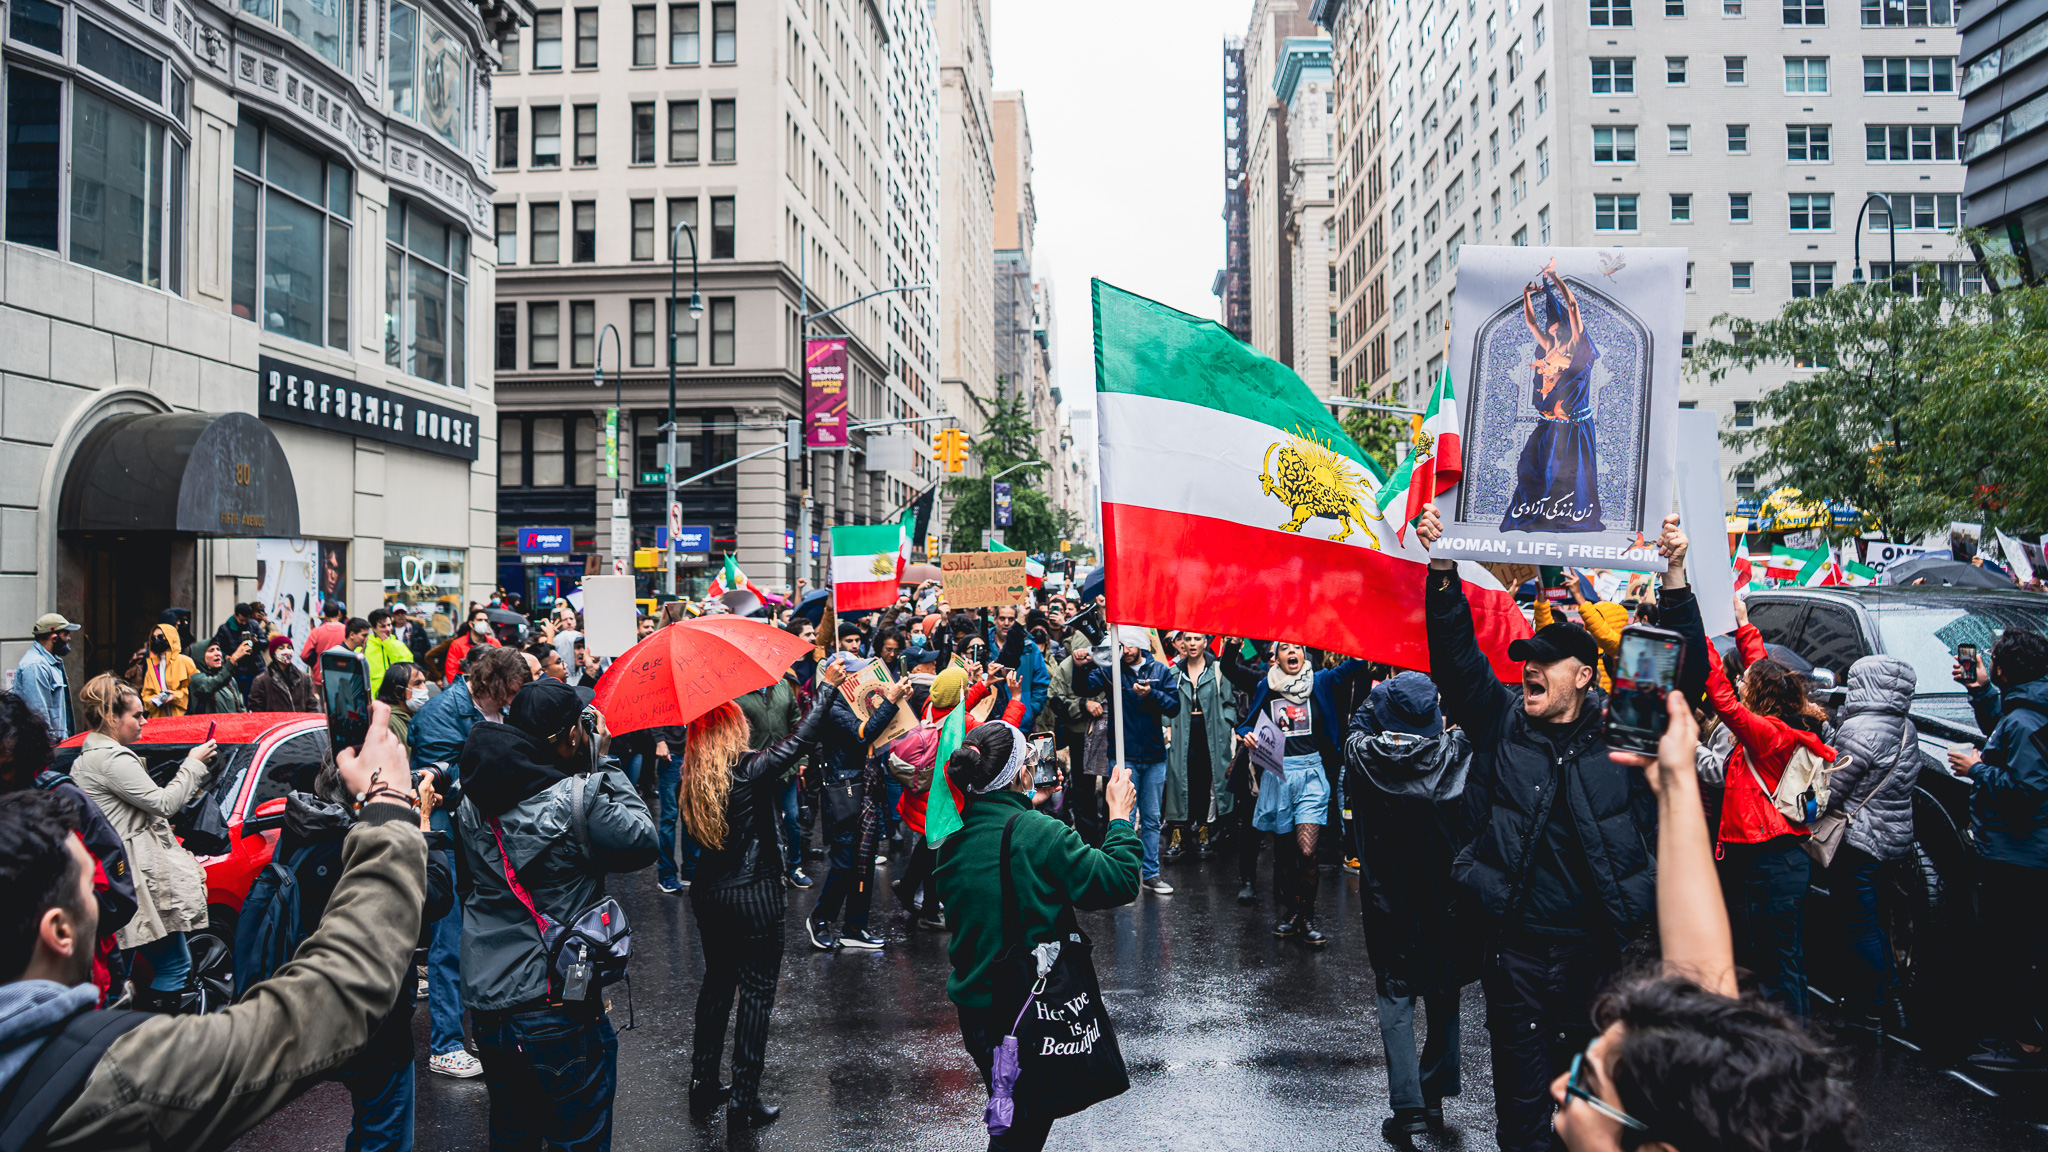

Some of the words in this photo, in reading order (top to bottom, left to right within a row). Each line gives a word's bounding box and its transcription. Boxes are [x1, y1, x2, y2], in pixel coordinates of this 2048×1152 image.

[811, 373, 844, 381] SHOPPING
[269, 370, 404, 431] PERFORMIX
[416, 409, 472, 447] HOUSE
[236, 462, 251, 485] 80
[1511, 496, 1551, 518] آزادی
[221, 512, 239, 525] FIFTH
[242, 514, 266, 528] AVENUE
[1437, 537, 1511, 556] WOMAN,
[1517, 540, 1563, 559] LIFE,
[1568, 543, 1660, 562] FREEDOM
[943, 572, 988, 589] WOMAN
[993, 569, 1021, 585] LIFE
[1544, 588, 1568, 598] FREEDOM
[1258, 730, 1276, 749] NIAC
[1035, 1000, 1065, 1021] Her
[1039, 1017, 1101, 1056] Beauiful
[1067, 1020, 1083, 1037] is
